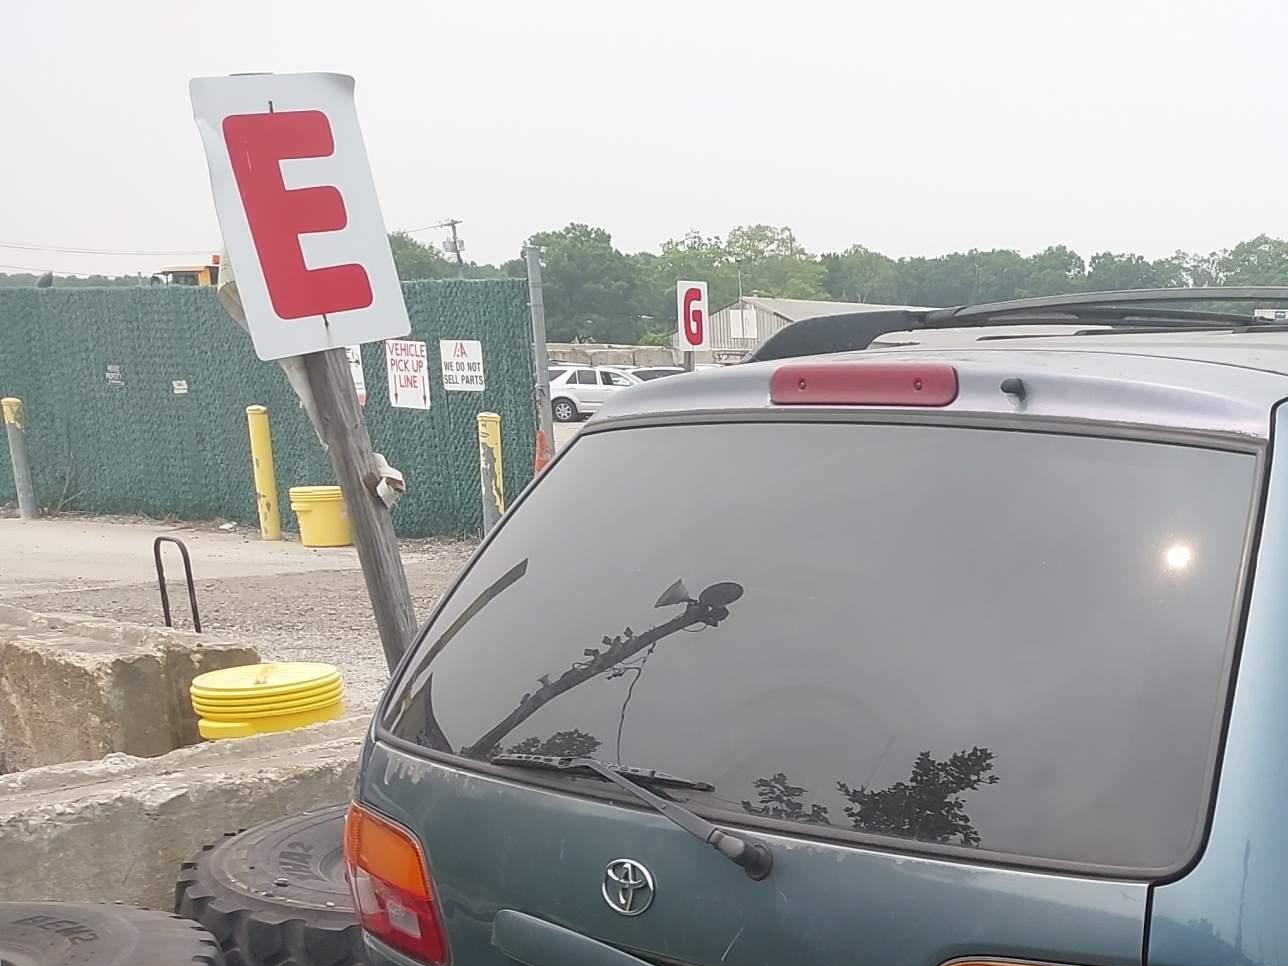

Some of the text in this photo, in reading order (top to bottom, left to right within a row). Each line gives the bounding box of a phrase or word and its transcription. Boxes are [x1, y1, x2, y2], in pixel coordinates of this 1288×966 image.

[222, 110, 374, 320] E
[684, 288, 704, 346] G
[387, 342, 426, 358] VEHICLE
[390, 358, 424, 373] PICK UP
[443, 361, 481, 373] WE DO NOT
[399, 375, 419, 389] LINE
[443, 375, 484, 386] SELL PARTS
